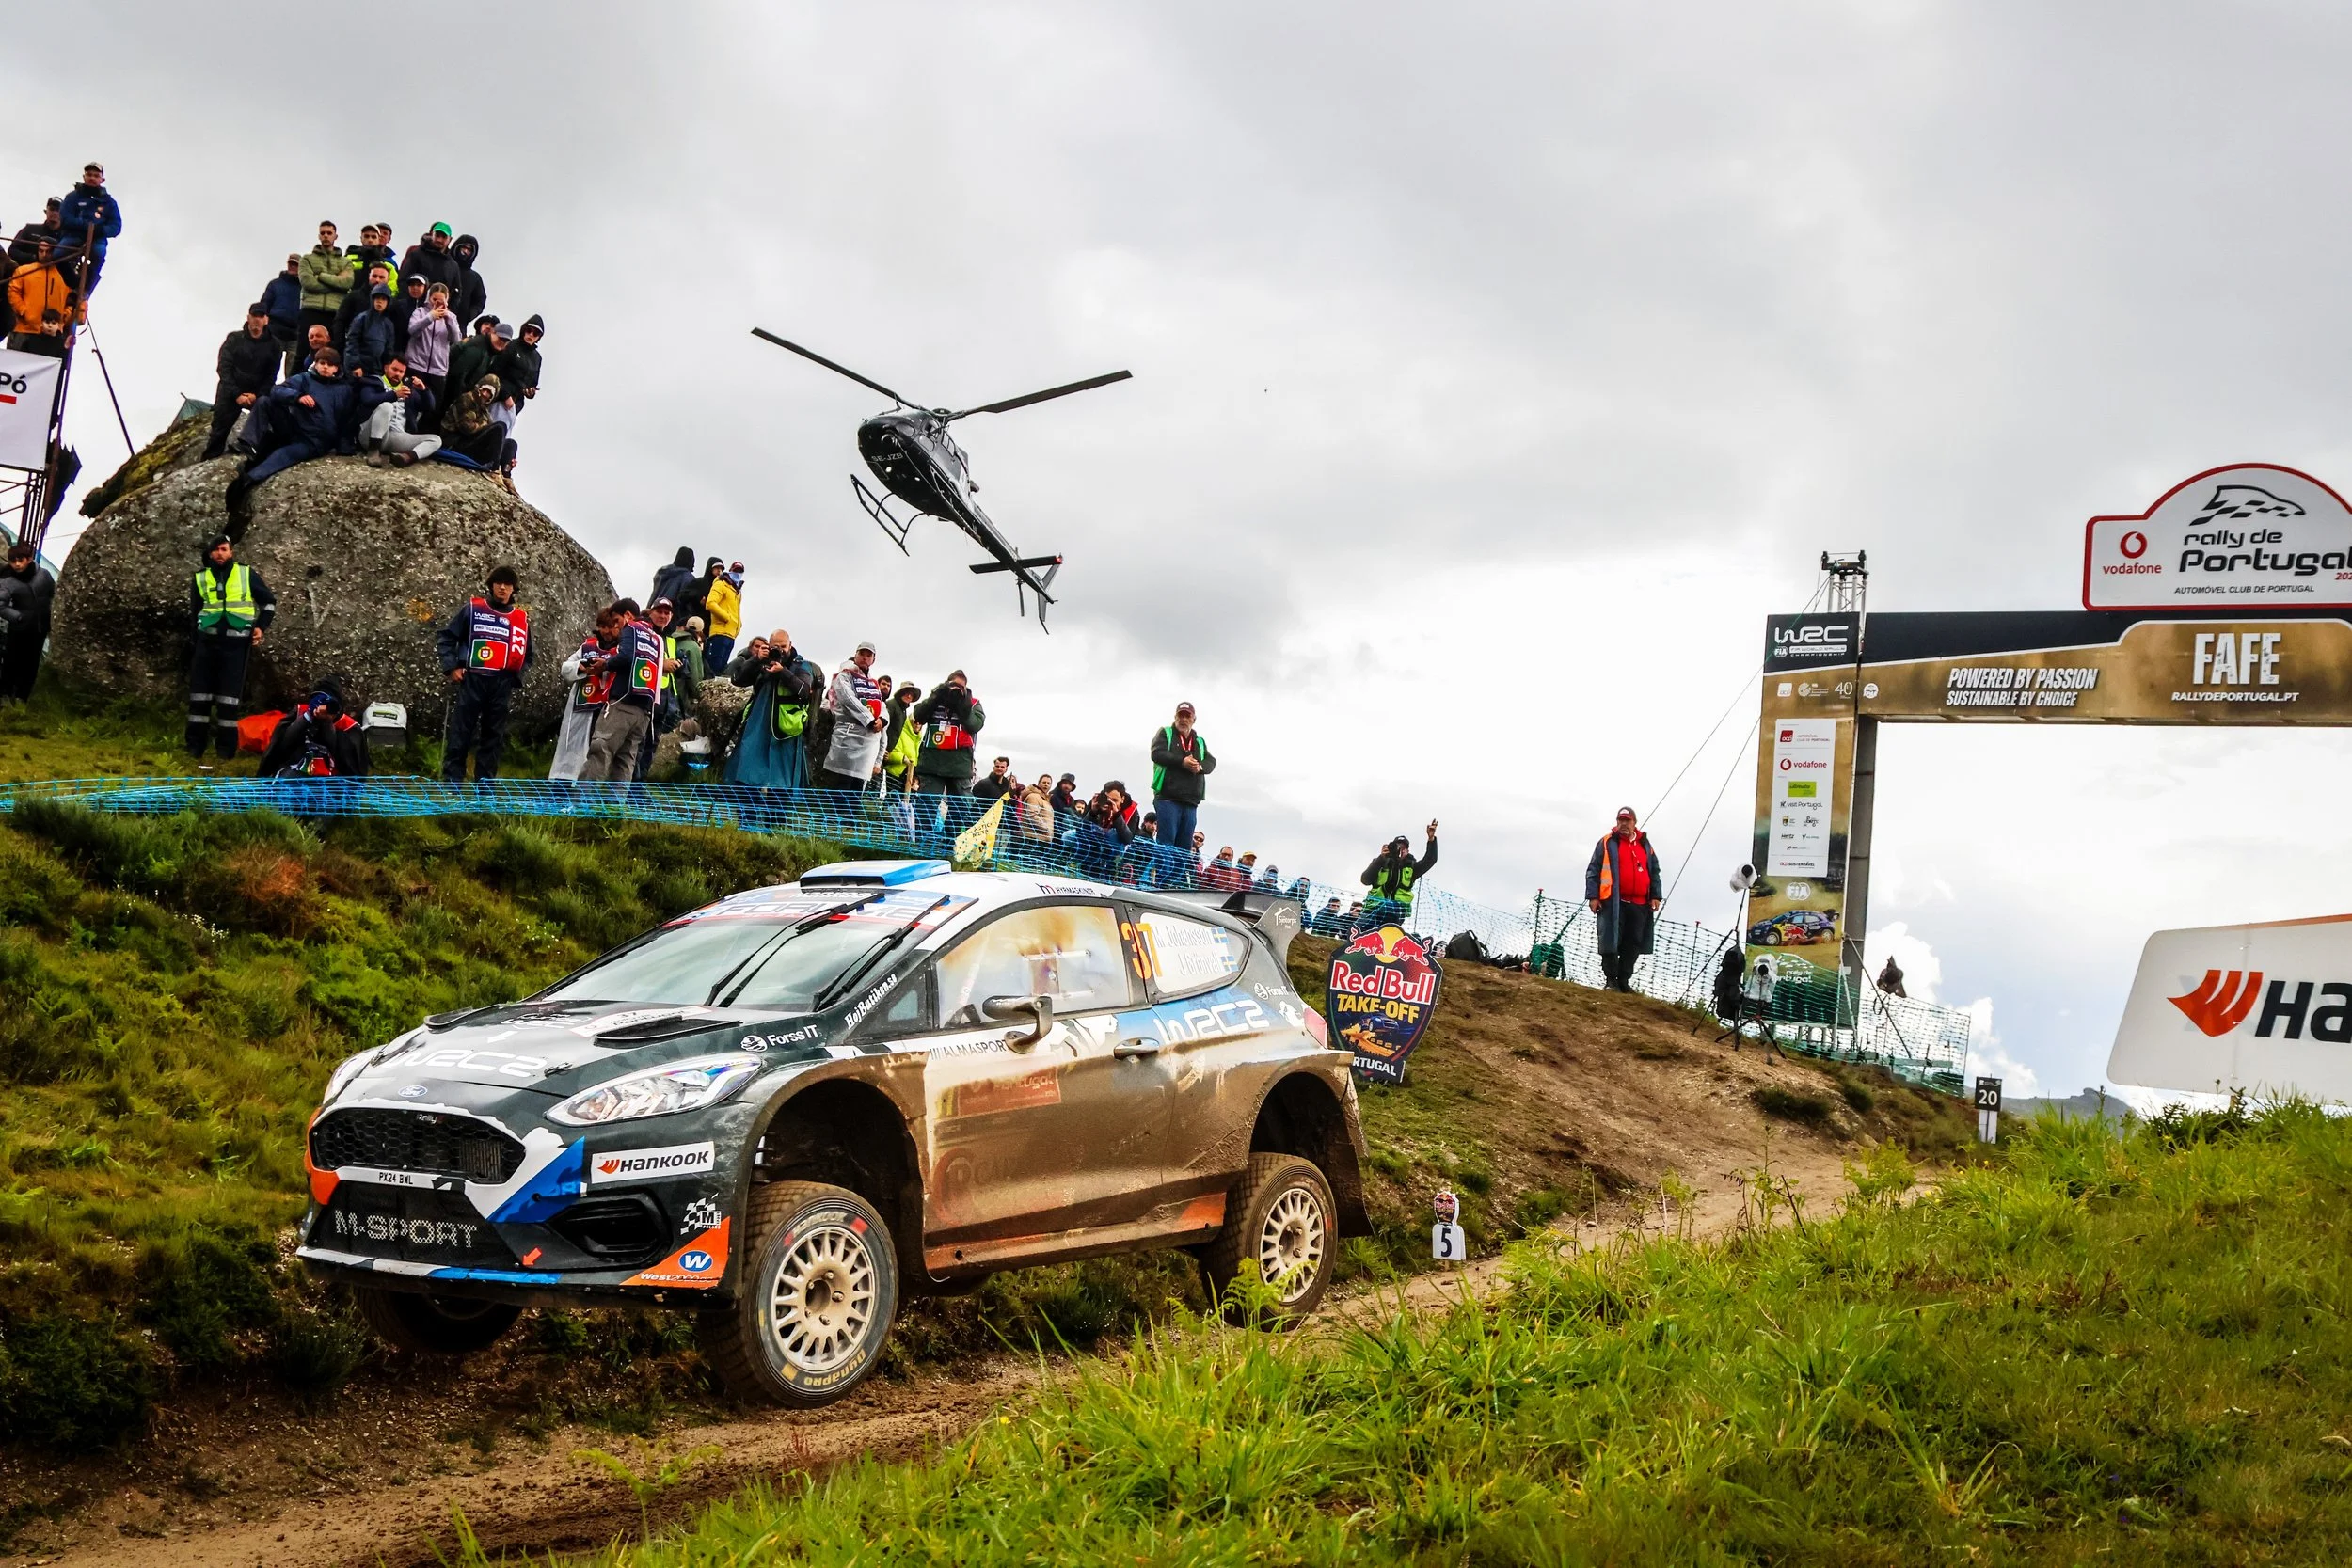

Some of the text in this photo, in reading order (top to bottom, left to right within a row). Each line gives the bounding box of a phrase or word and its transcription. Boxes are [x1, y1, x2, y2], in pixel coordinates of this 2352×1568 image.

[871, 452, 903, 461] SE-JZB
[2184, 529, 2283, 548] rally de
[2103, 562, 2161, 575] vodafone
[2174, 585, 2226, 594] AUTOMÓVEL
[511, 626, 526, 655] 237
[1774, 625, 1849, 643] WRC
[2193, 632, 2281, 685] FAFE
[1947, 668, 2098, 689] POWERED BY PASSION
[1835, 682, 1853, 695] 40
[2171, 691, 2299, 703] RALLYDEPORTUGAL.PT
[1947, 691, 2078, 707] SUSTAINABLE BY CHOICE
[1798, 801, 1822, 810] Portugal
[1167, 925, 1213, 948] Johansson
[1120, 922, 1163, 979] 37
[1330, 960, 1437, 1006] Red Bull
[1337, 993, 1421, 1024] TAKE-OFF
[2255, 980, 2352, 1044] Ha
[1153, 999, 1270, 1045] WRC2
[767, 1024, 818, 1047] Forss IT
[379, 1049, 547, 1078] WRC2
[1353, 1056, 1397, 1077] RTUGAL
[400, 1086, 425, 1096] Ford
[1979, 1089, 1998, 1106] 20
[379, 1172, 413, 1185] PX24 BWL
[702, 1212, 714, 1224] M
[1441, 1227, 1452, 1257] 5
[685, 1254, 709, 1269] W
